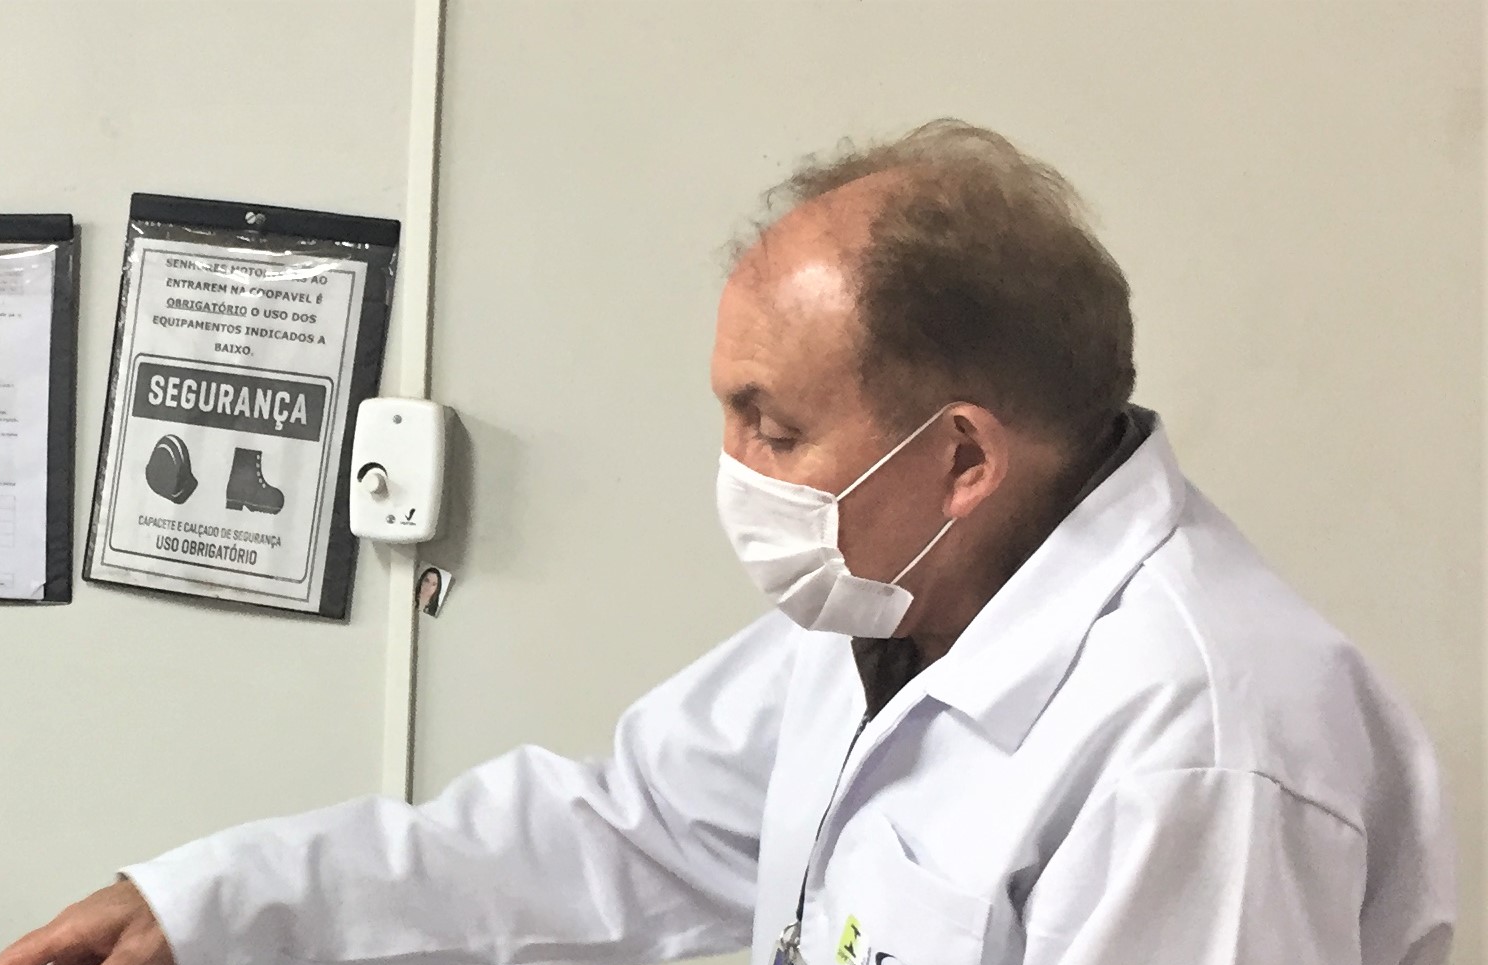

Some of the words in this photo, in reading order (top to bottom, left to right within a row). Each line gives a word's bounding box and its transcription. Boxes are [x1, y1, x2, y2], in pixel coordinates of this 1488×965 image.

[166, 257, 227, 274] SENHES
[311, 275, 328, 286] AO
[166, 277, 227, 293] ENTRAREM
[230, 285, 246, 295] NA
[249, 287, 312, 304] COOPAVEL
[166, 297, 247, 317] OBRIGATÓRIO
[250, 307, 260, 317] O
[263, 308, 288, 321] USO
[291, 312, 317, 324] DOS
[152, 315, 241, 335] EQUIPAMENTOS
[244, 327, 314, 344] INDICADOS
[316, 335, 326, 345] A
[214, 342, 254, 357] BAIXO.
[148, 375, 307, 430] SEGURANÇA
[138, 514, 176, 531] CAPACETE
[177, 521, 183, 532] E
[183, 522, 220, 538] CALÇADO
[220, 527, 232, 540] DE
[233, 529, 281, 549] SEGURANÇA
[156, 535, 180, 552] USO
[181, 538, 258, 566] OBRIGATÓRIO
